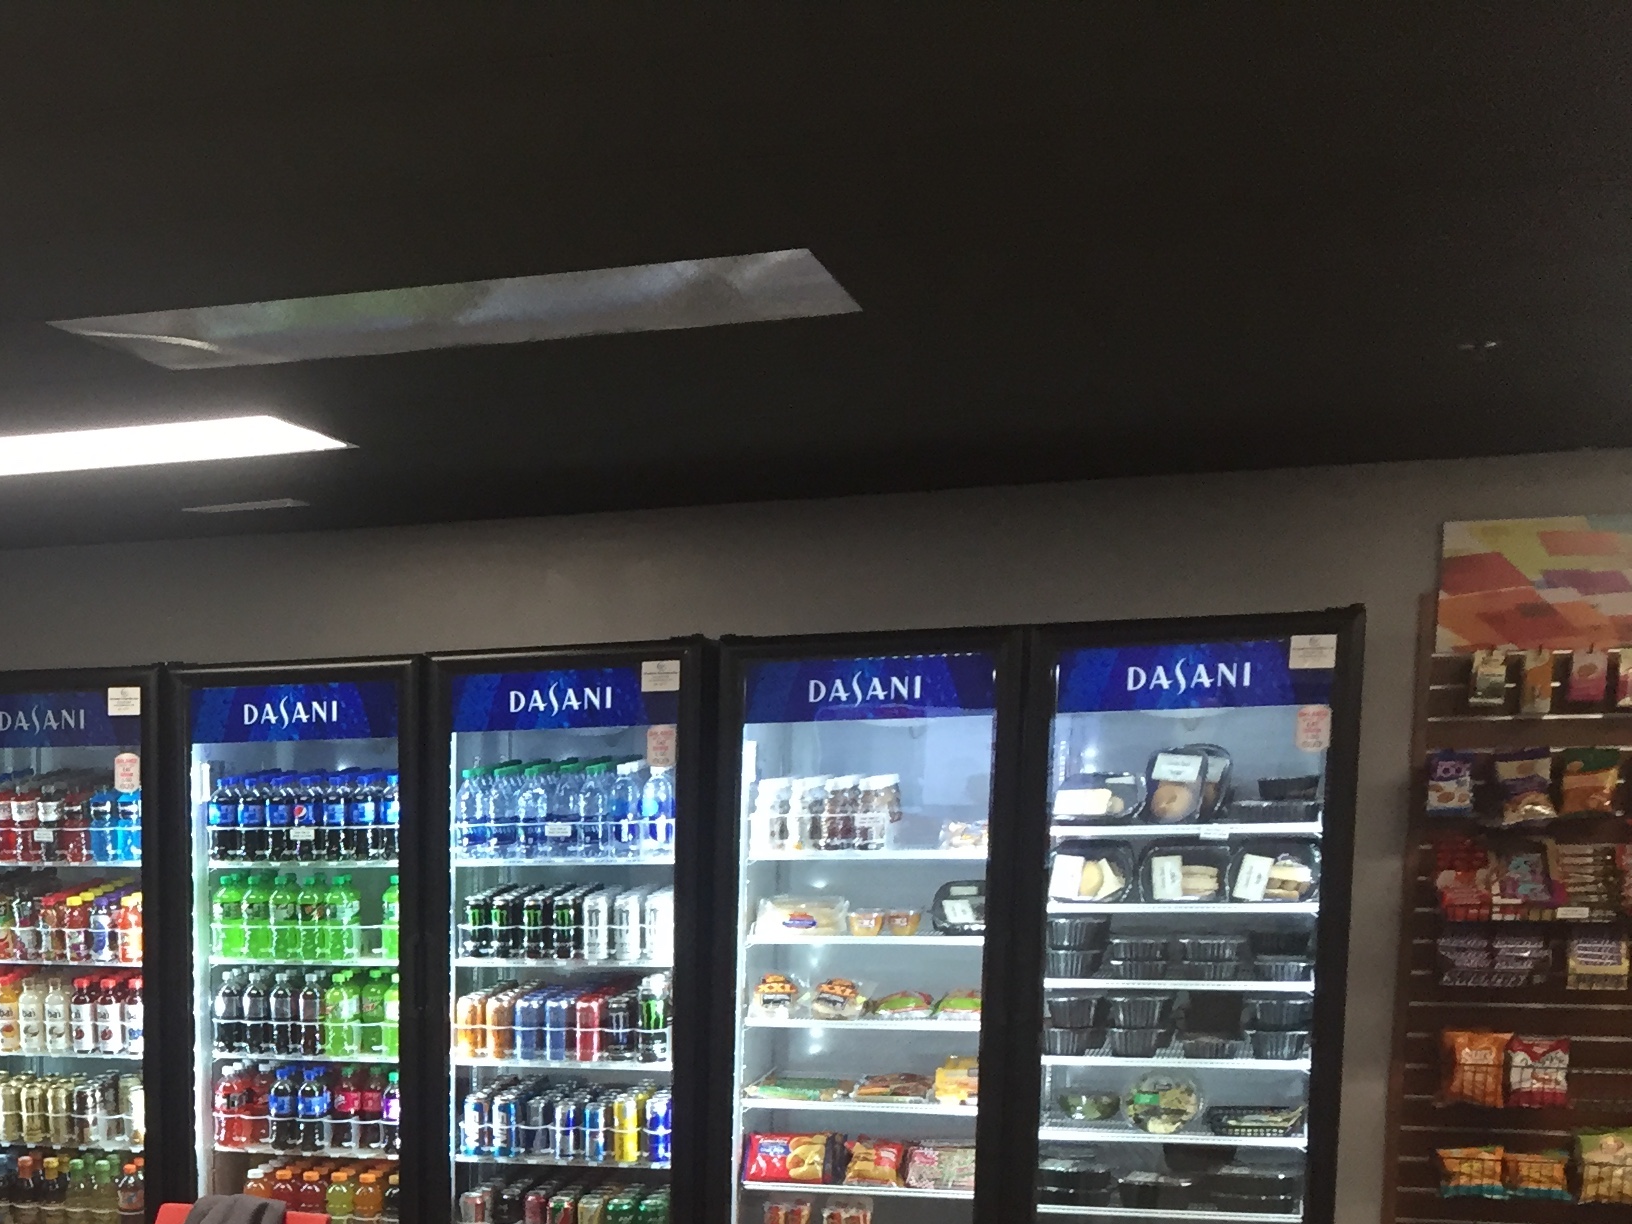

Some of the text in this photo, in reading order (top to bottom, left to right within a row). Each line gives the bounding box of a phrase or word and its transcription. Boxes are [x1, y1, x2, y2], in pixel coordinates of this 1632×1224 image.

[808, 671, 923, 707] DASANI
[1127, 658, 1252, 694] DASANI
[243, 697, 339, 728] DASANI
[509, 683, 613, 716] DASANI
